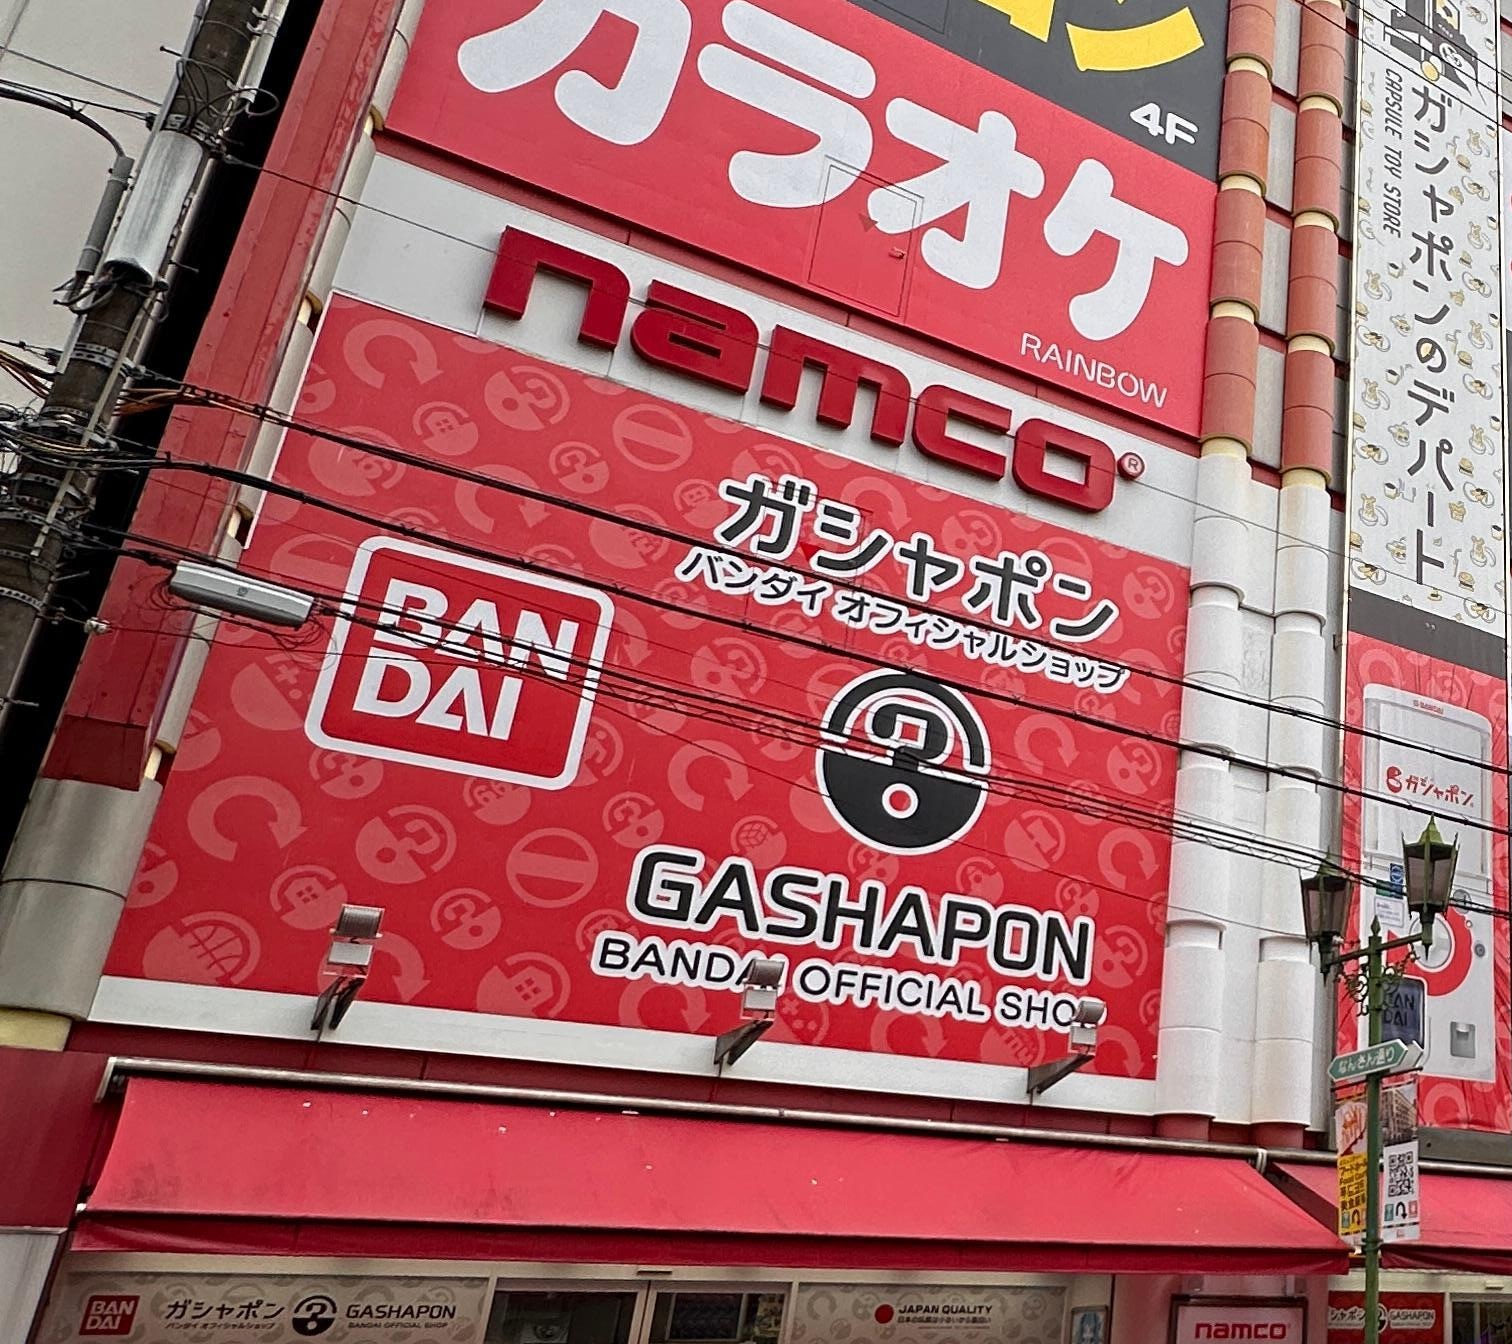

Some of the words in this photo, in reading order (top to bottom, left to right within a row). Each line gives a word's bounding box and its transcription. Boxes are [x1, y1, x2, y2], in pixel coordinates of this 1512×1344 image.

[1129, 101, 1201, 147] 4F
[1385, 68, 1403, 141] CAPSULE
[1384, 146, 1402, 173] TOY
[1382, 177, 1401, 239] STORE
[1406, 84, 1455, 584] ガシャポンのデパート
[1018, 331, 1169, 409] RAINBOW
[719, 477, 1116, 639] ガシャポン
[377, 577, 582, 682] BAN
[681, 552, 829, 612] バンダイ
[838, 594, 1127, 690] オフィシャルショップ
[349, 652, 526, 741] DAI
[1405, 773, 1474, 807] ガシャポン
[634, 851, 1089, 980] GASHAPON
[799, 963, 985, 1015] OFFICIAL
[1001, 990, 1090, 1029] SHO
[85, 1315, 121, 1331] DAI
[90, 1301, 136, 1316] BAN
[164, 1300, 286, 1321] ガシャポン
[345, 1303, 457, 1320] GASHAPON
[899, 1304, 939, 1315] JAPAN
[941, 1304, 993, 1316] QUALITY
[1194, 1321, 1287, 1340] namco
